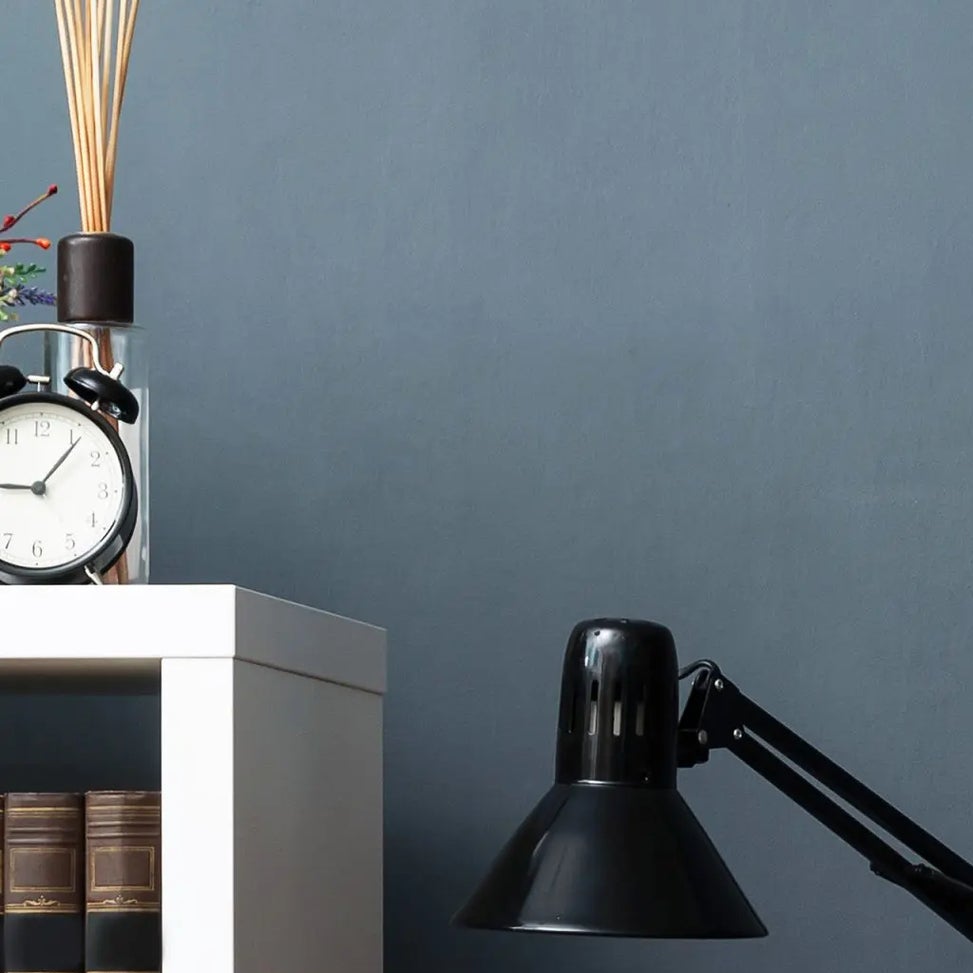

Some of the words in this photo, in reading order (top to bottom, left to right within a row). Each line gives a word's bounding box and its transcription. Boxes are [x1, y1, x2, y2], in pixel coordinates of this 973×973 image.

[6, 428, 18, 445] 11
[34, 420, 50, 437] 12
[90, 451, 100, 467] 2
[97, 483, 109, 499] 3
[88, 512, 98, 528] 4
[3, 533, 13, 550] 7
[32, 540, 43, 558] 6
[65, 533, 76, 550] 5
